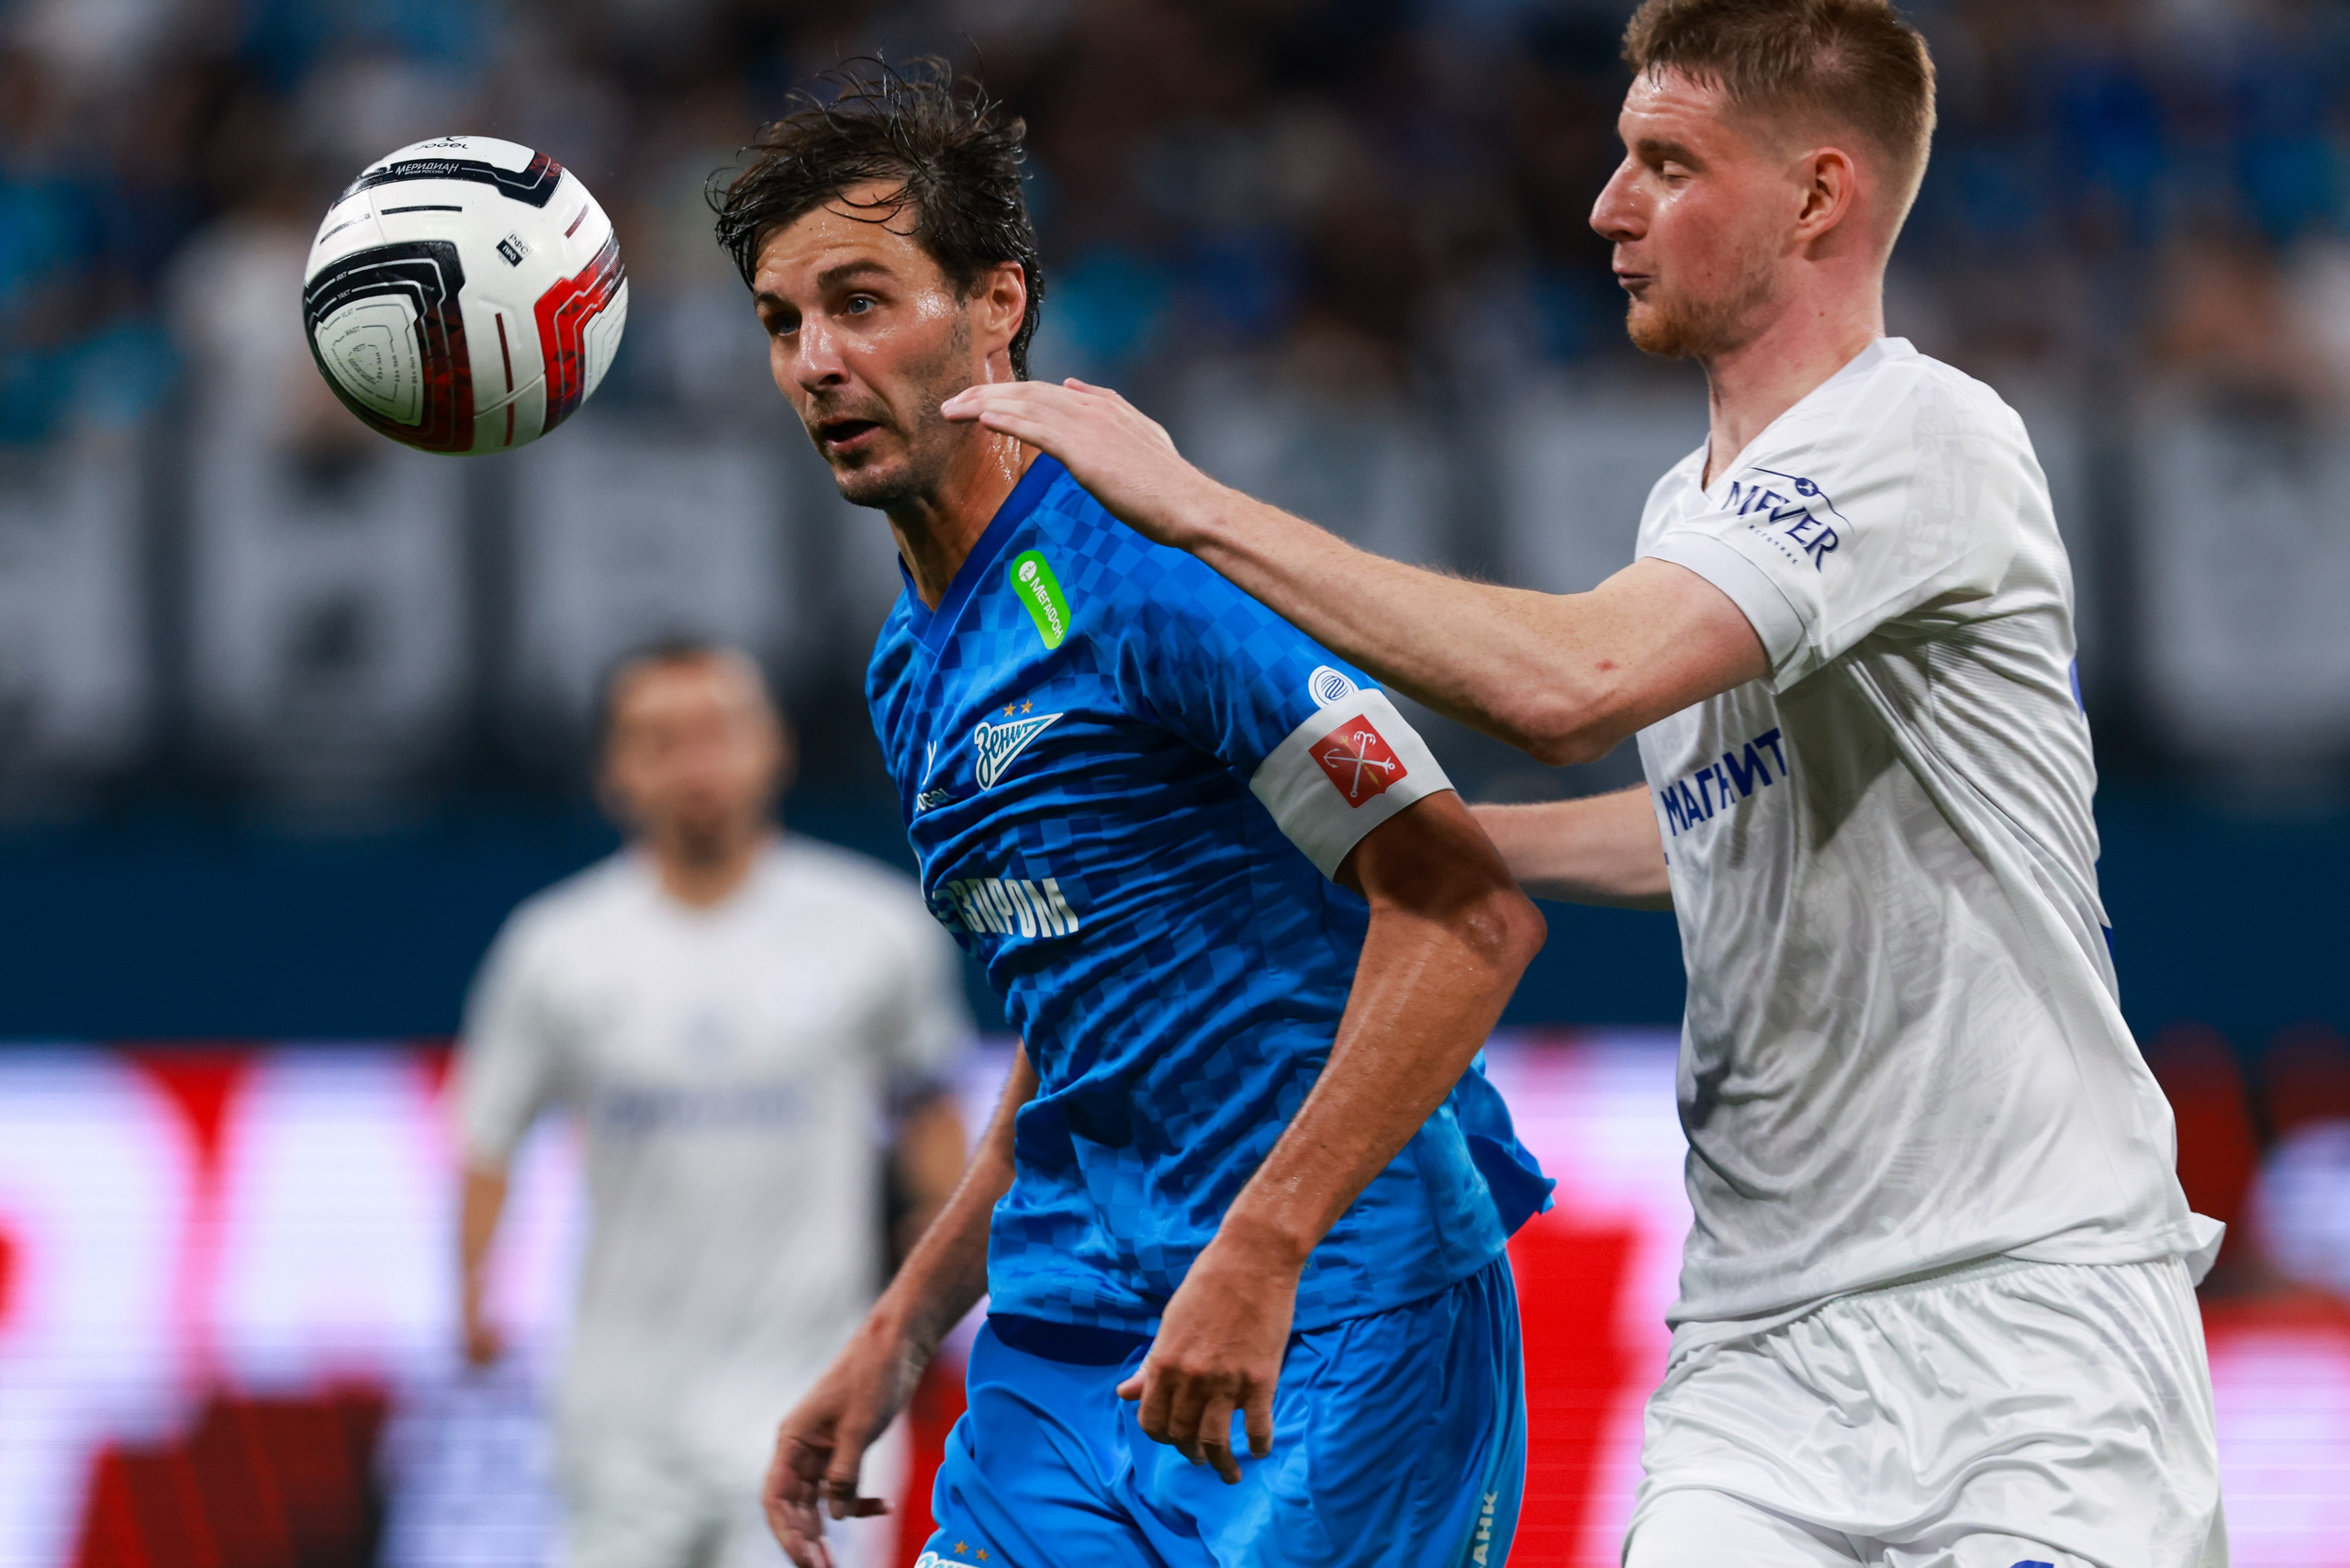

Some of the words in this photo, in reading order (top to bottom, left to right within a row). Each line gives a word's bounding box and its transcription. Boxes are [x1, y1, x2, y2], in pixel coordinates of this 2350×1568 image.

[395, 162, 459, 175] МЕРИДИАН
[509, 233, 529, 255] РФС
[1030, 577, 1064, 639] МЕГАФОН
[976, 715, 1058, 790] Зенит
[1660, 727, 1787, 837] МАГНИТ
[1472, 1490, 1499, 1568] АНК
